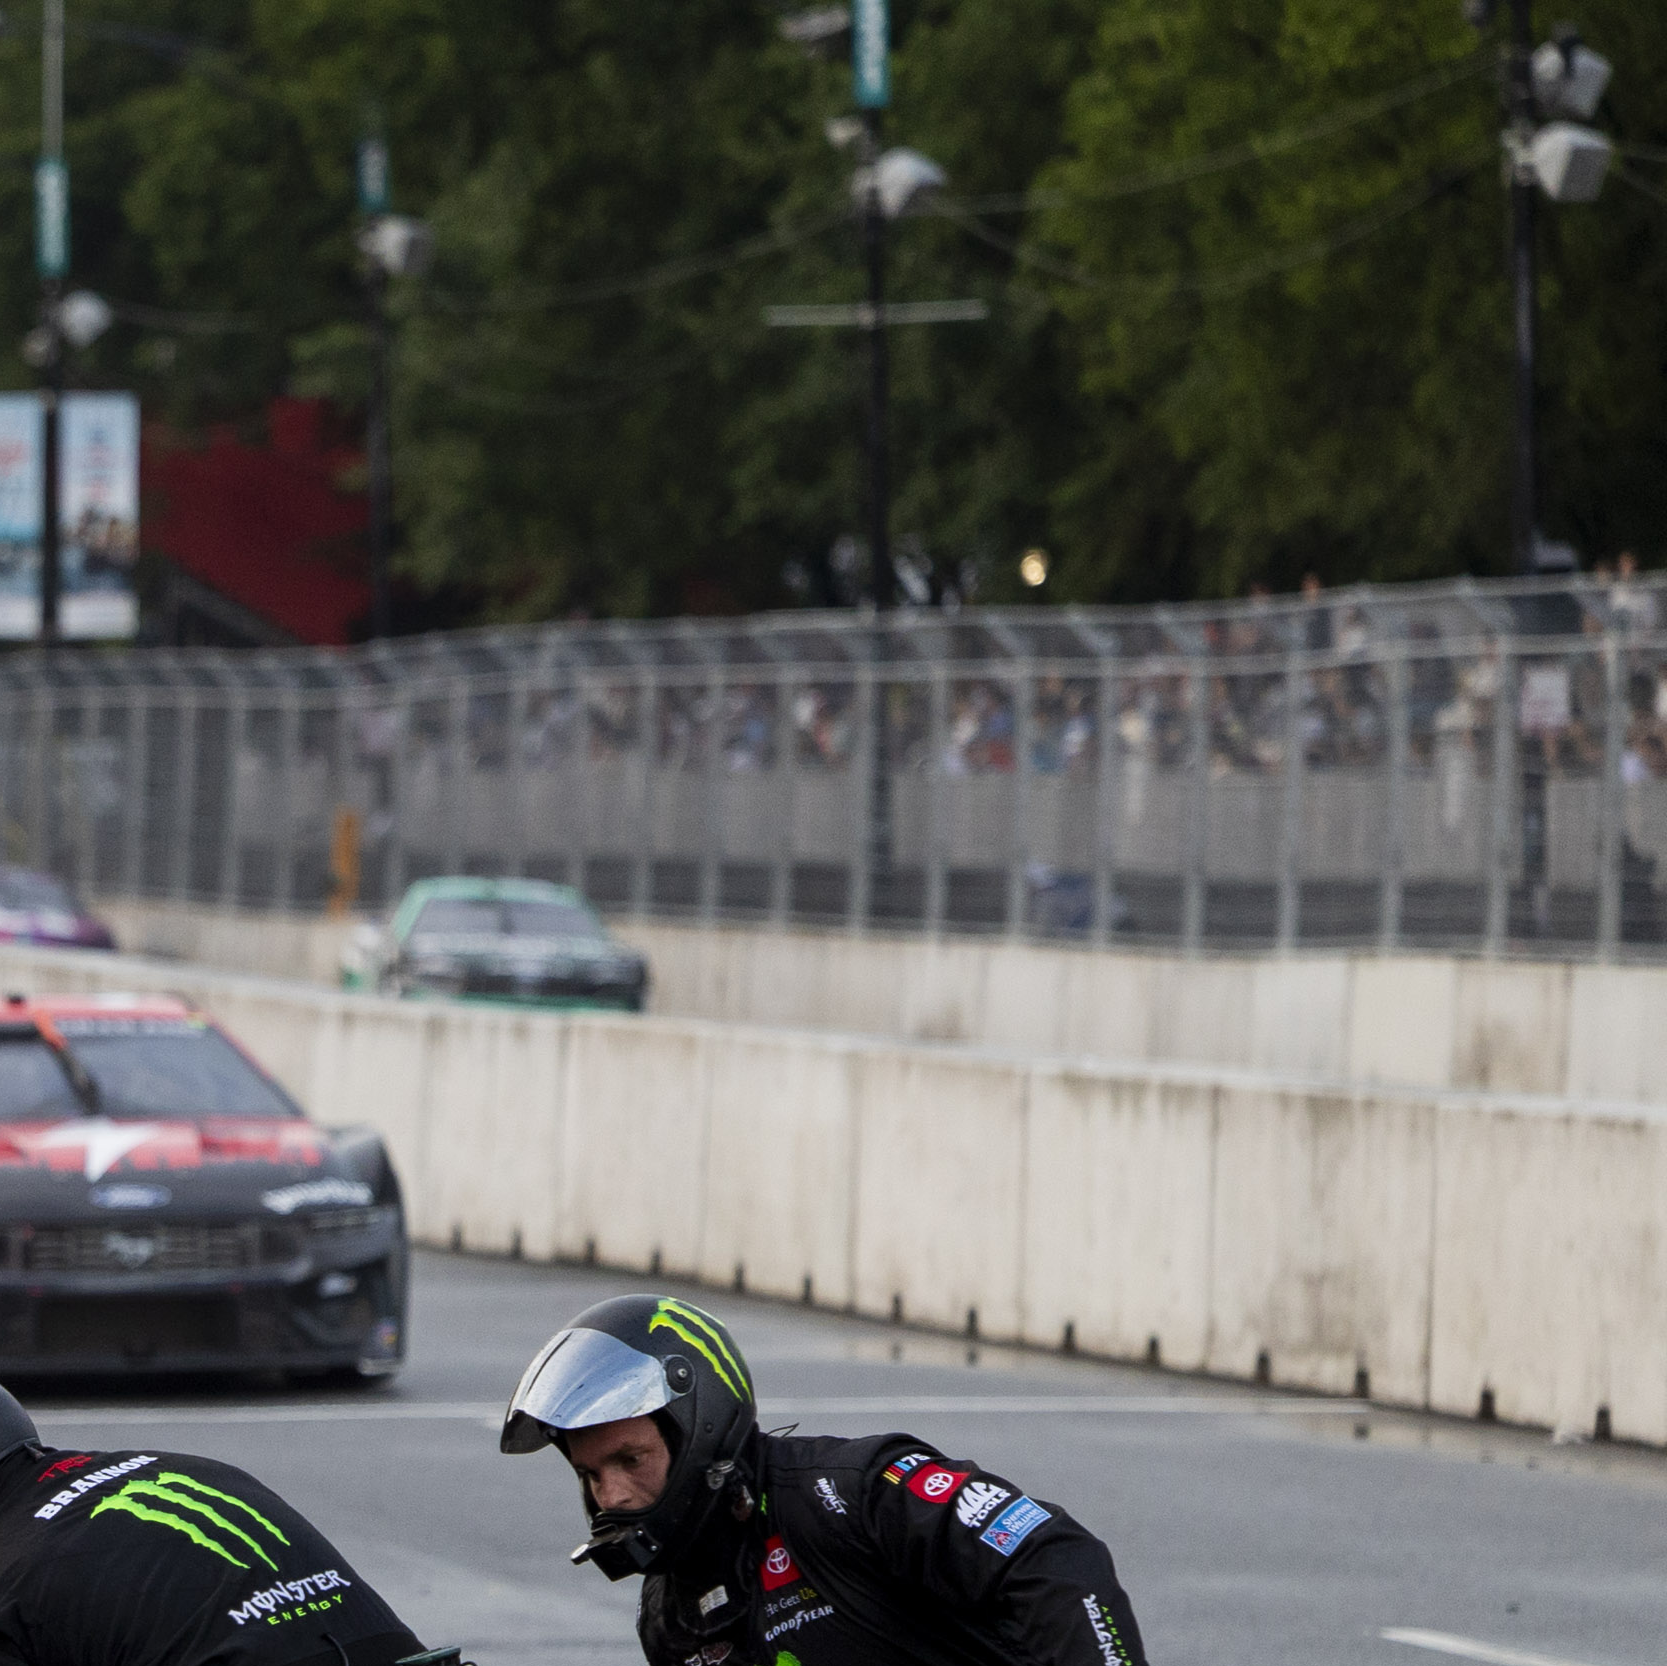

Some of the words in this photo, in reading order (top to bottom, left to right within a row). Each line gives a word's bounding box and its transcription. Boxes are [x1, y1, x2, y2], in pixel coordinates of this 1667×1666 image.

[34, 1455, 159, 1521] BRANNON
[956, 1481, 1004, 1528] MAC
[968, 1489, 1012, 1529] TOOLS
[227, 1569, 352, 1625] MONSTER
[267, 1594, 343, 1626] ENERGY
[779, 1593, 801, 1610] Gets
[765, 1605, 834, 1642] GOODYEAR
